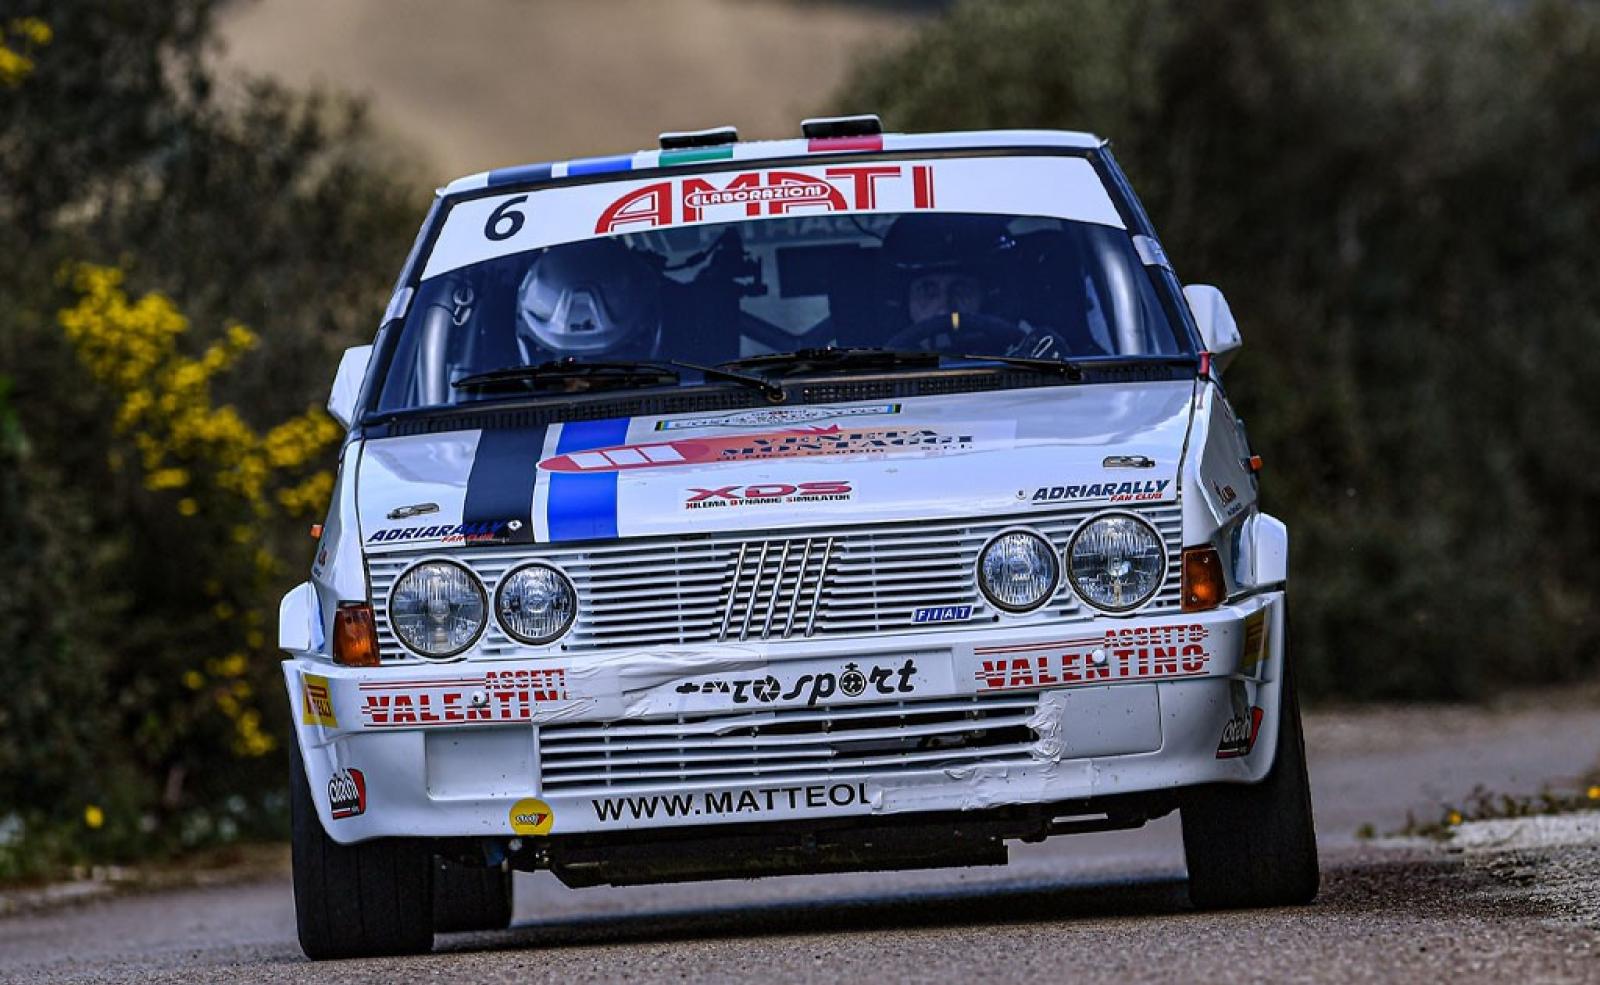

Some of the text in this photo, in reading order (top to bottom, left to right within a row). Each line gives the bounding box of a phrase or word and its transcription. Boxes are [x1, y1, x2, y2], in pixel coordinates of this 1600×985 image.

[594, 165, 934, 234] AMATI
[692, 186, 821, 206] ELABORAZIONI
[484, 195, 529, 241] 6
[686, 481, 852, 502] XDS
[1032, 479, 1171, 500] ADRIARALLY
[1110, 492, 1163, 503] FAN CLUB
[729, 498, 782, 507] DYNAMIC
[785, 494, 851, 504] SIMULATOR
[367, 521, 506, 542] ADRIARALLY
[916, 606, 969, 621] FIAT
[1103, 623, 1209, 648] ASSETTO
[976, 644, 1210, 687] VALENTINO
[485, 669, 564, 689] ASSETT
[362, 690, 567, 722] VALENTI
